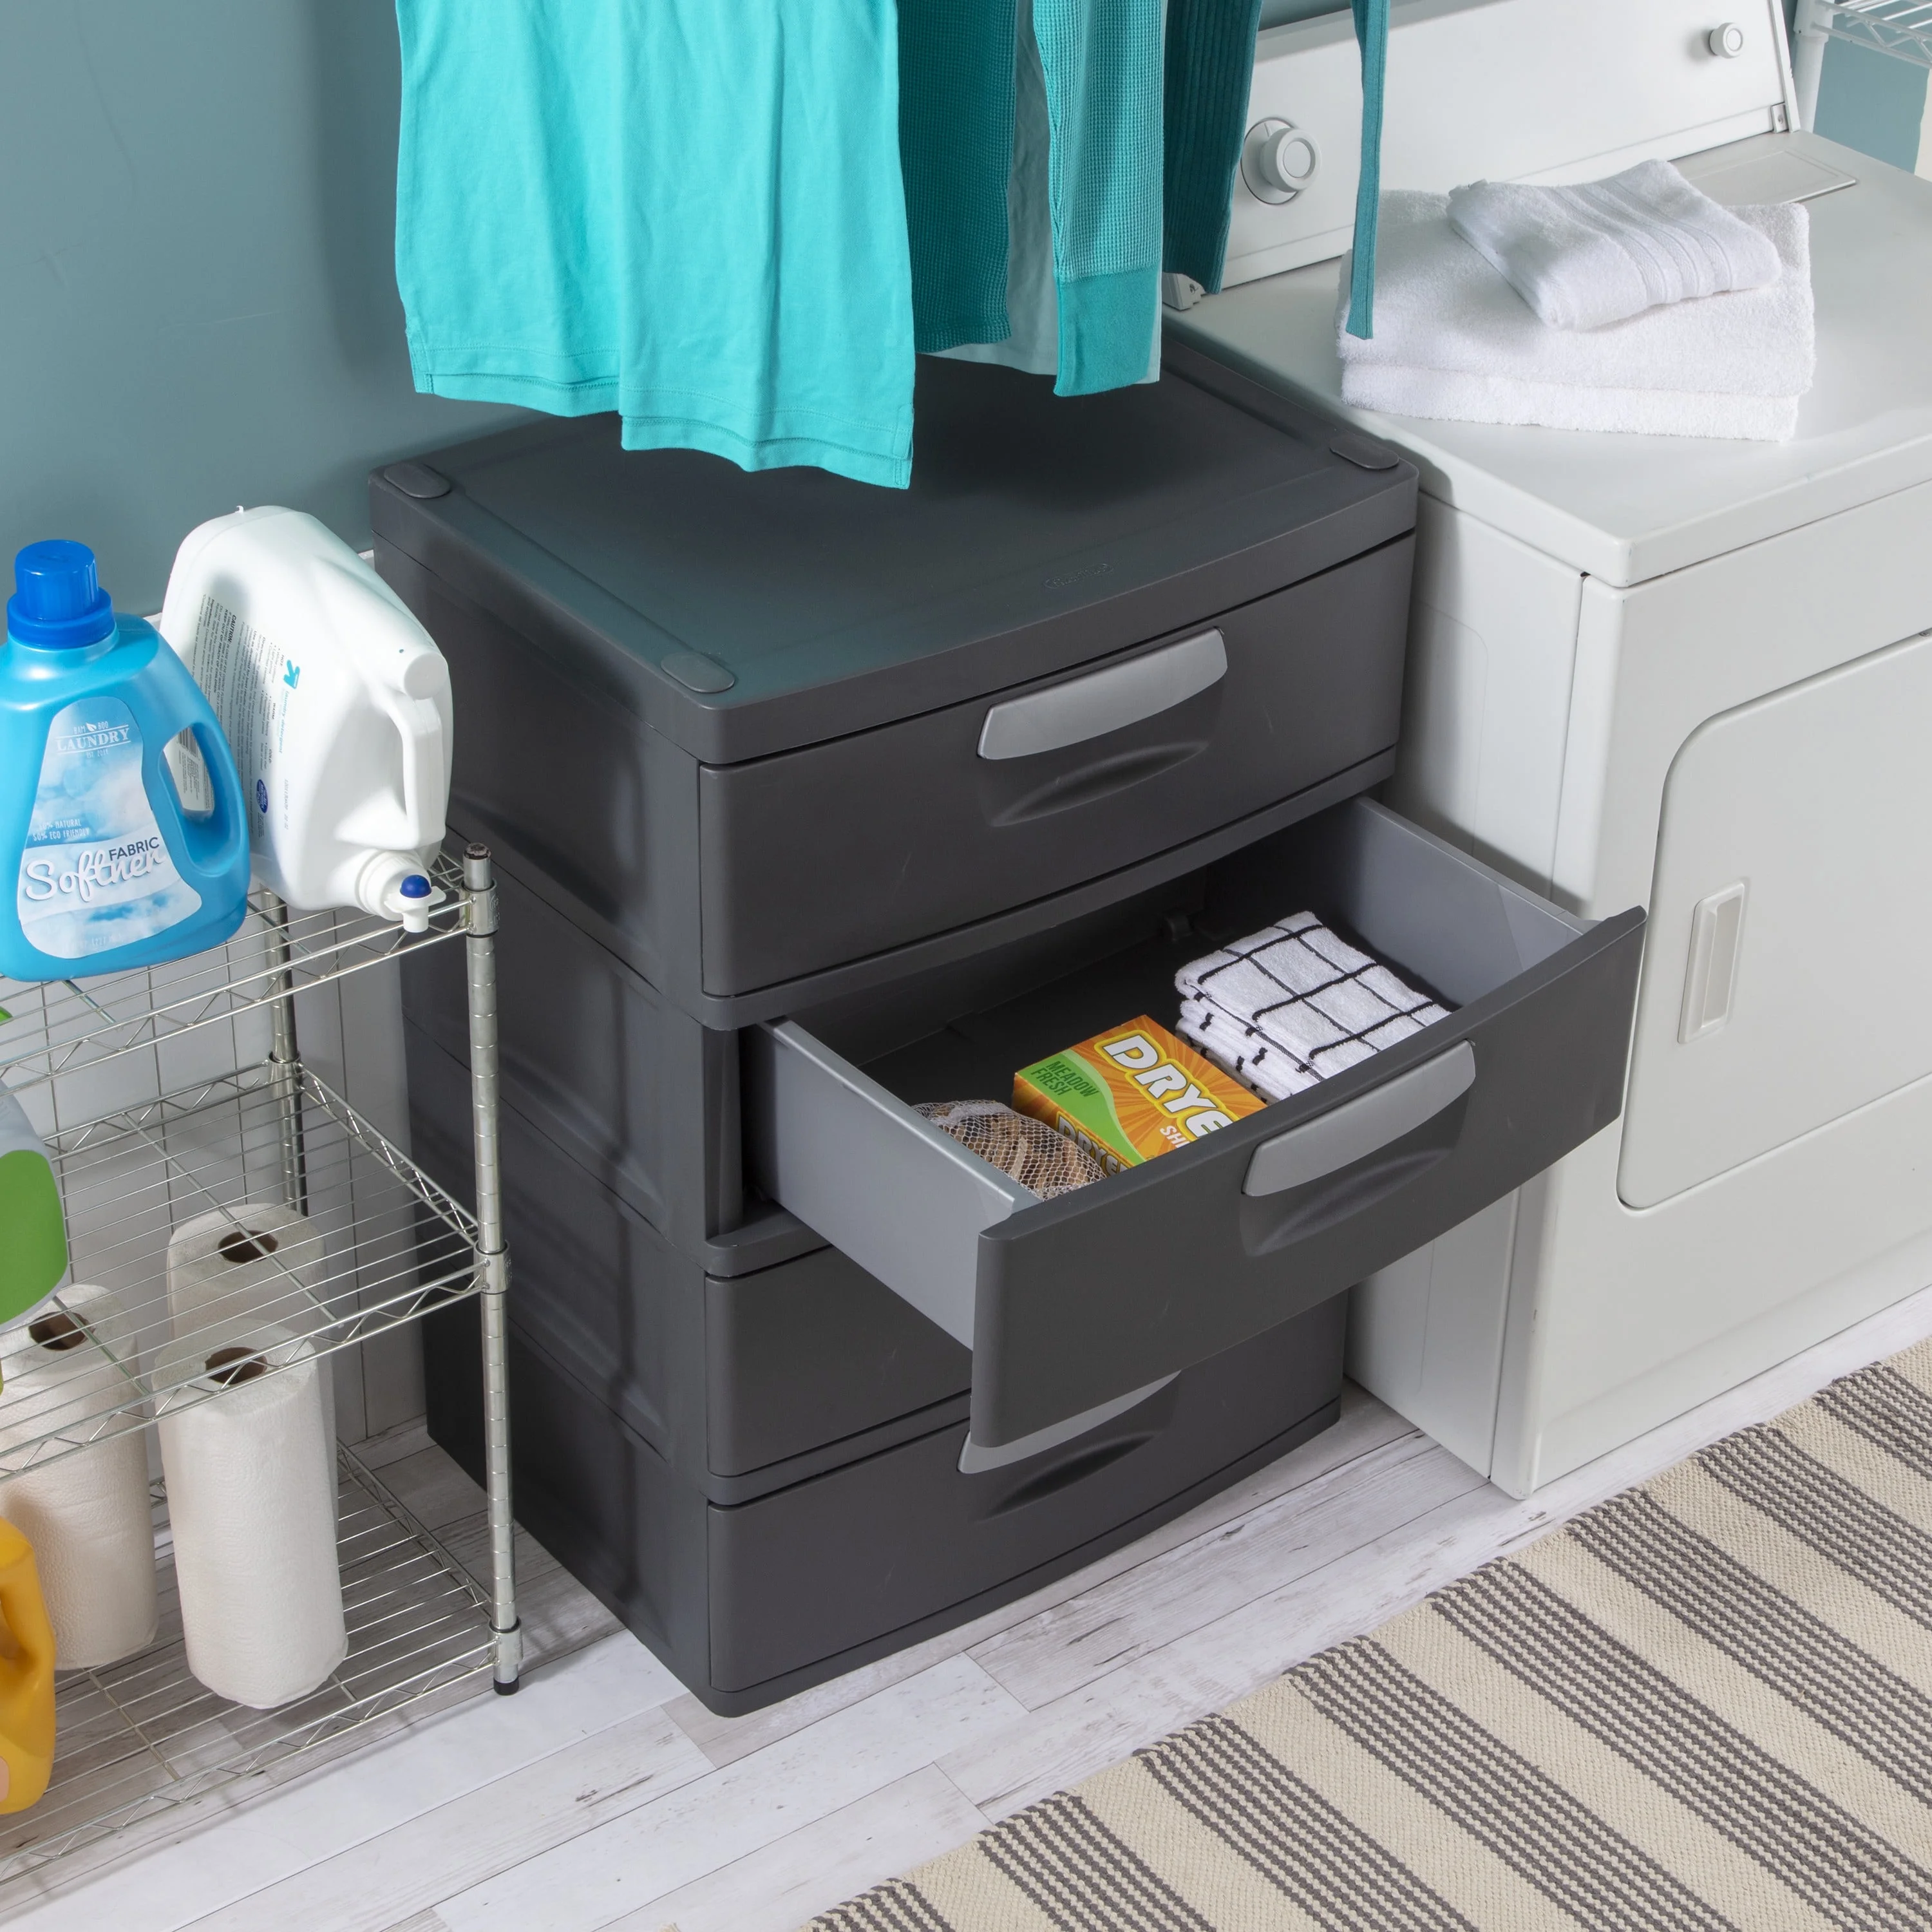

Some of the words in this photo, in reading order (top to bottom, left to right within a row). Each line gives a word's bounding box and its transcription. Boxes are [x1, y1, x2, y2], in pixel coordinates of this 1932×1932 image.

[227, 615, 236, 645] CAUTION:
[57, 728, 129, 752] LAUNDRY
[73, 726, 86, 735] BAM
[97, 721, 109, 730] BOO
[49, 831, 61, 840] ECO
[62, 827, 90, 838] FRIENDLY
[55, 819, 82, 829] NATURAL
[109, 837, 160, 861] FABRIC
[25, 849, 164, 903] Softner
[1030, 1067, 1072, 1095] FRESH
[1045, 1061, 1100, 1097] MEADOW
